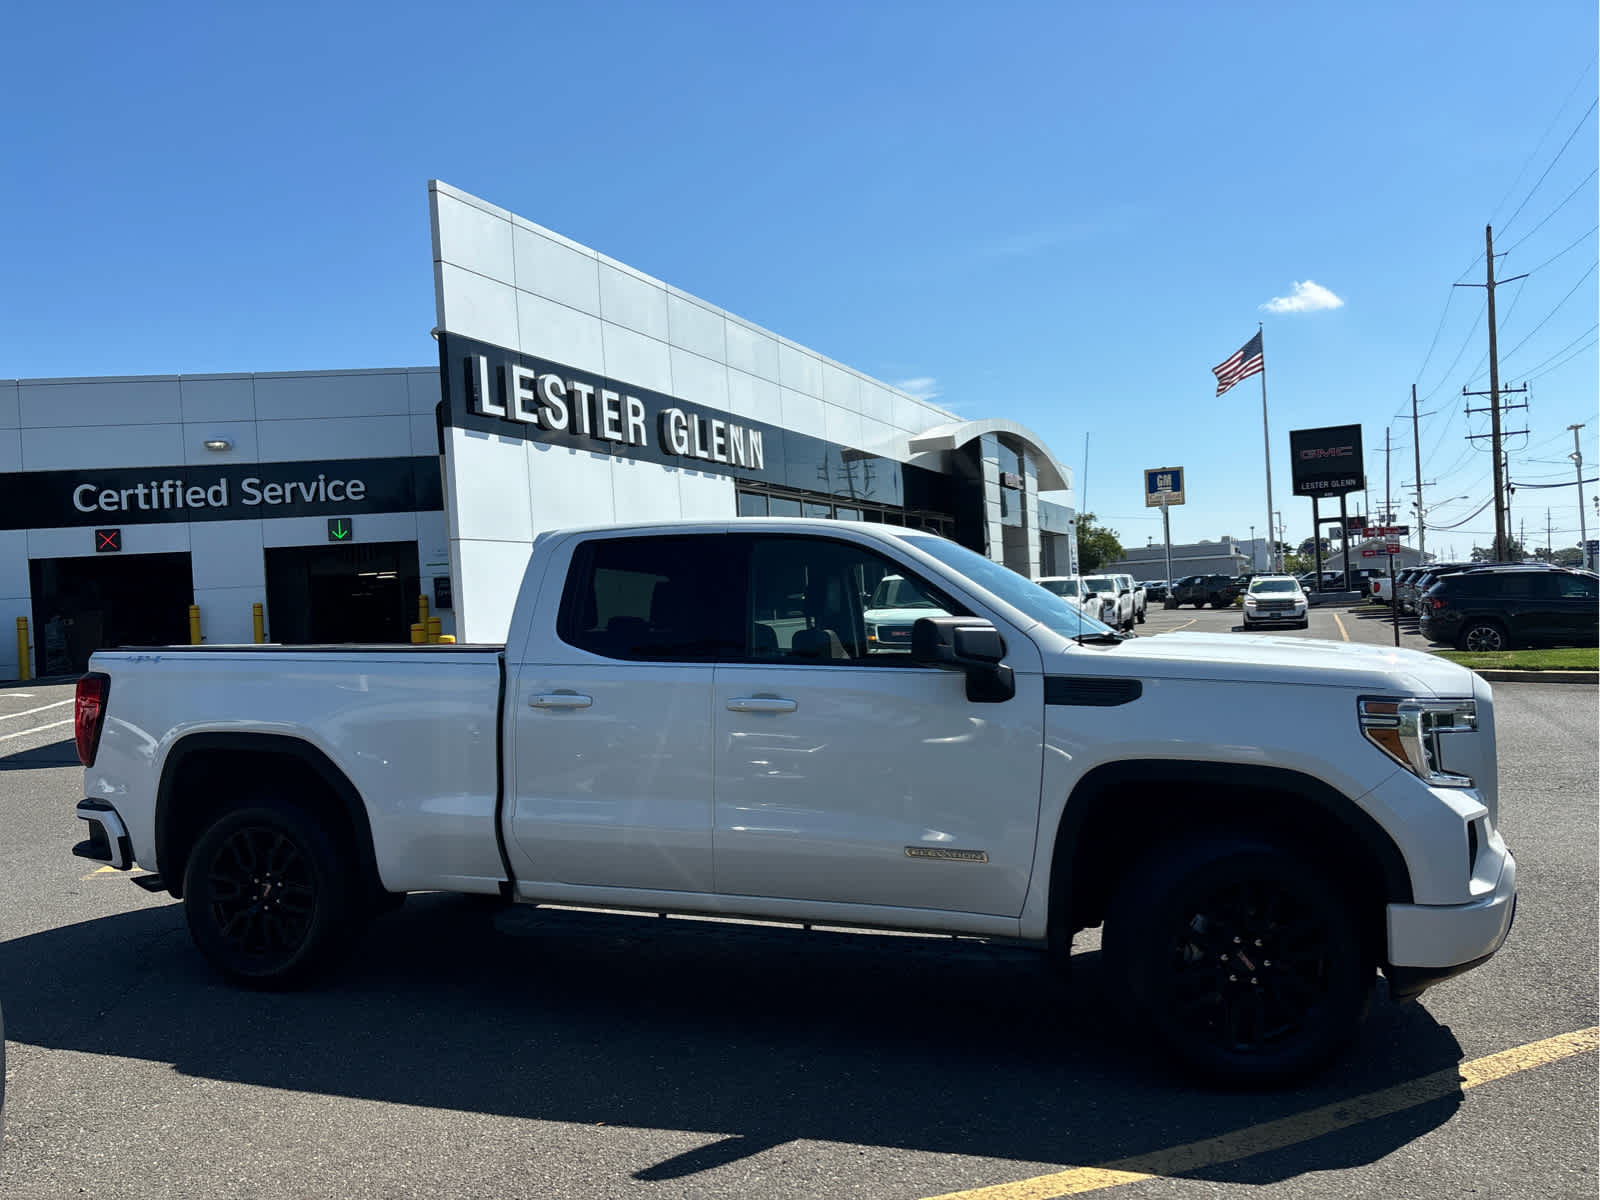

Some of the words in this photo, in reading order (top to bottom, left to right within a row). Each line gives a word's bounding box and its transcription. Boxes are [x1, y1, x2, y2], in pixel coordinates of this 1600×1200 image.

[474, 355, 648, 446] LESTER
[661, 408, 765, 470] GLENN
[1300, 446, 1353, 460] GMC
[1156, 473, 1172, 488] GM
[1301, 481, 1329, 490] LESTER
[1331, 479, 1356, 488] GLENN
[72, 477, 229, 512] Certified
[241, 474, 366, 505] Service
